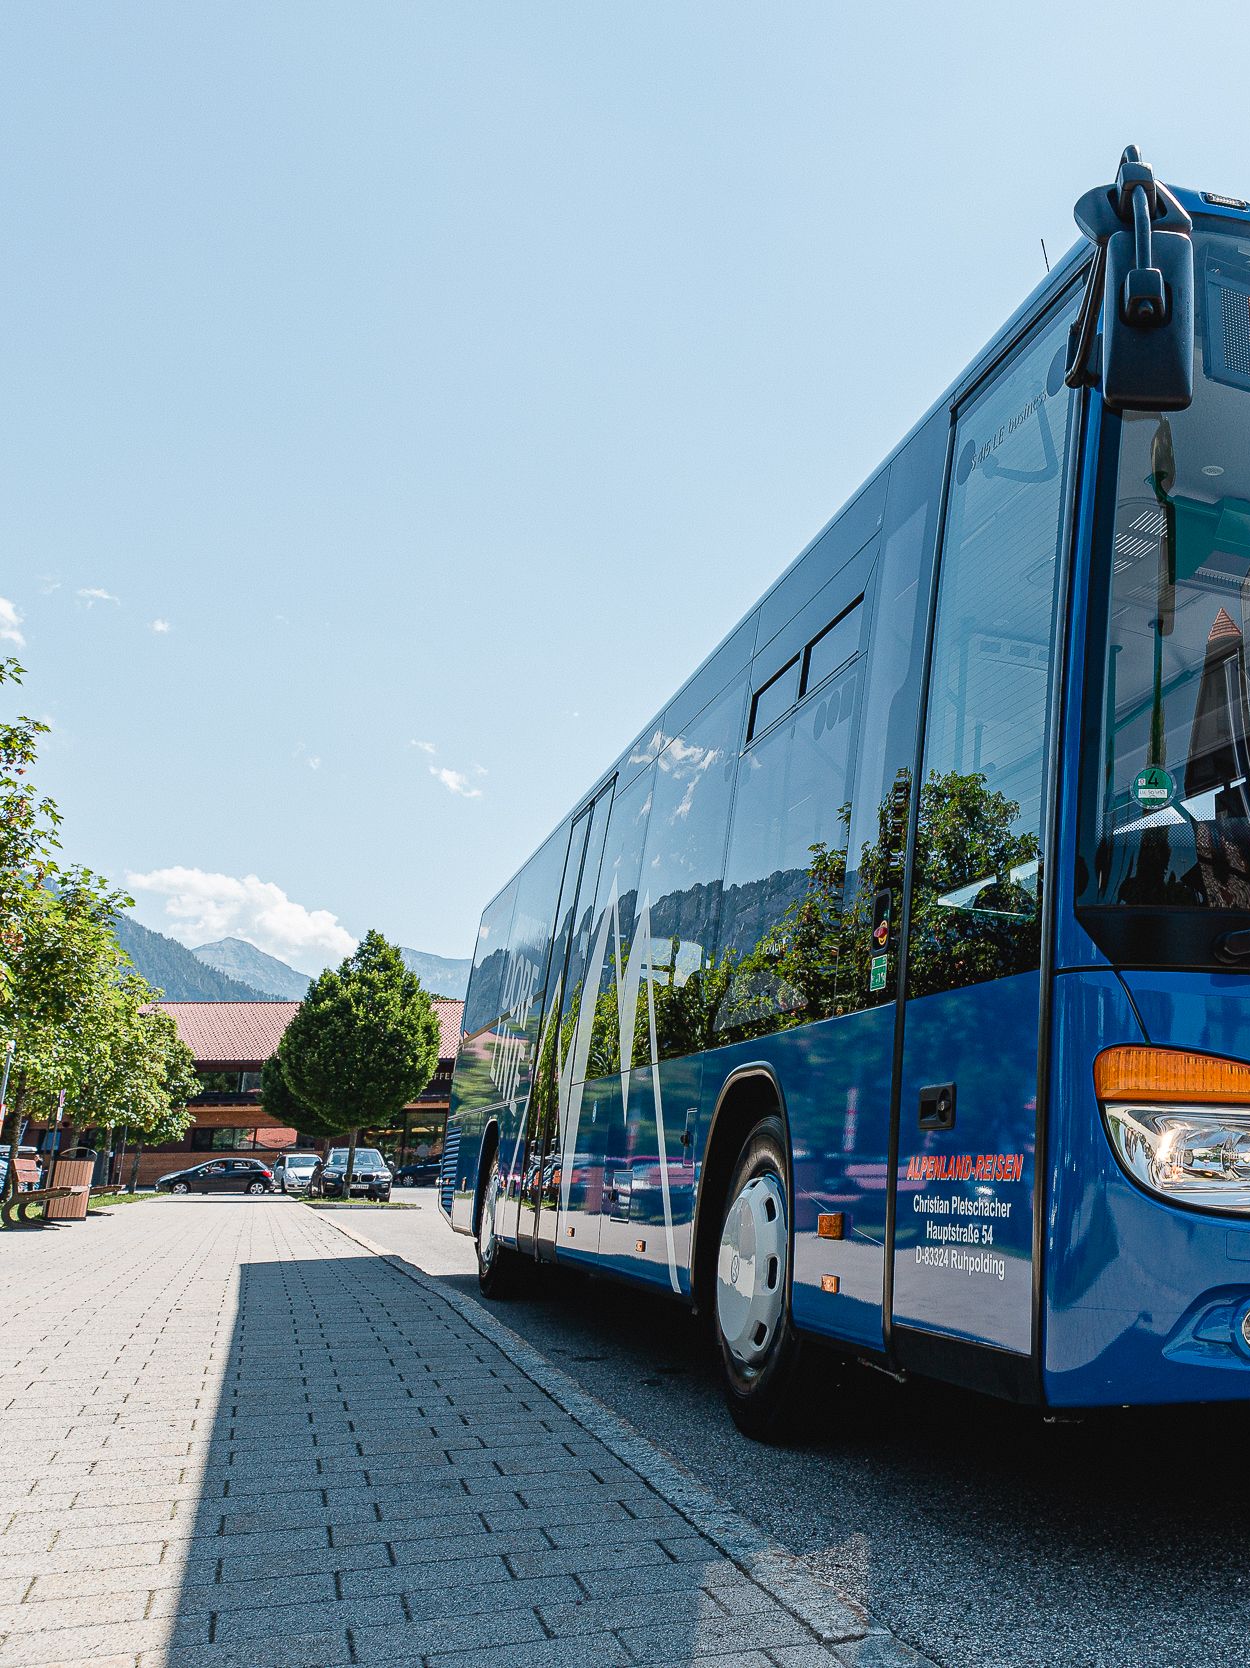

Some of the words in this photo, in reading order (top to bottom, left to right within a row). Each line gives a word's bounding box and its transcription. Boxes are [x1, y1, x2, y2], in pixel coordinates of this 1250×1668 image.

[992, 426, 1005, 451] LE
[1008, 390, 1047, 434] business
[1148, 770, 1159, 788] 4
[502, 951, 540, 1031] DORF
[906, 1153, 1024, 1182] ALPENLAND-REISEN
[913, 1194, 950, 1214] Christian
[951, 1196, 1011, 1218] Pletschacher
[926, 1220, 980, 1244] Hauptstraße
[981, 1224, 994, 1245] 54
[915, 1245, 949, 1268] D-83324
[951, 1249, 1005, 1280] Ruhpolding
